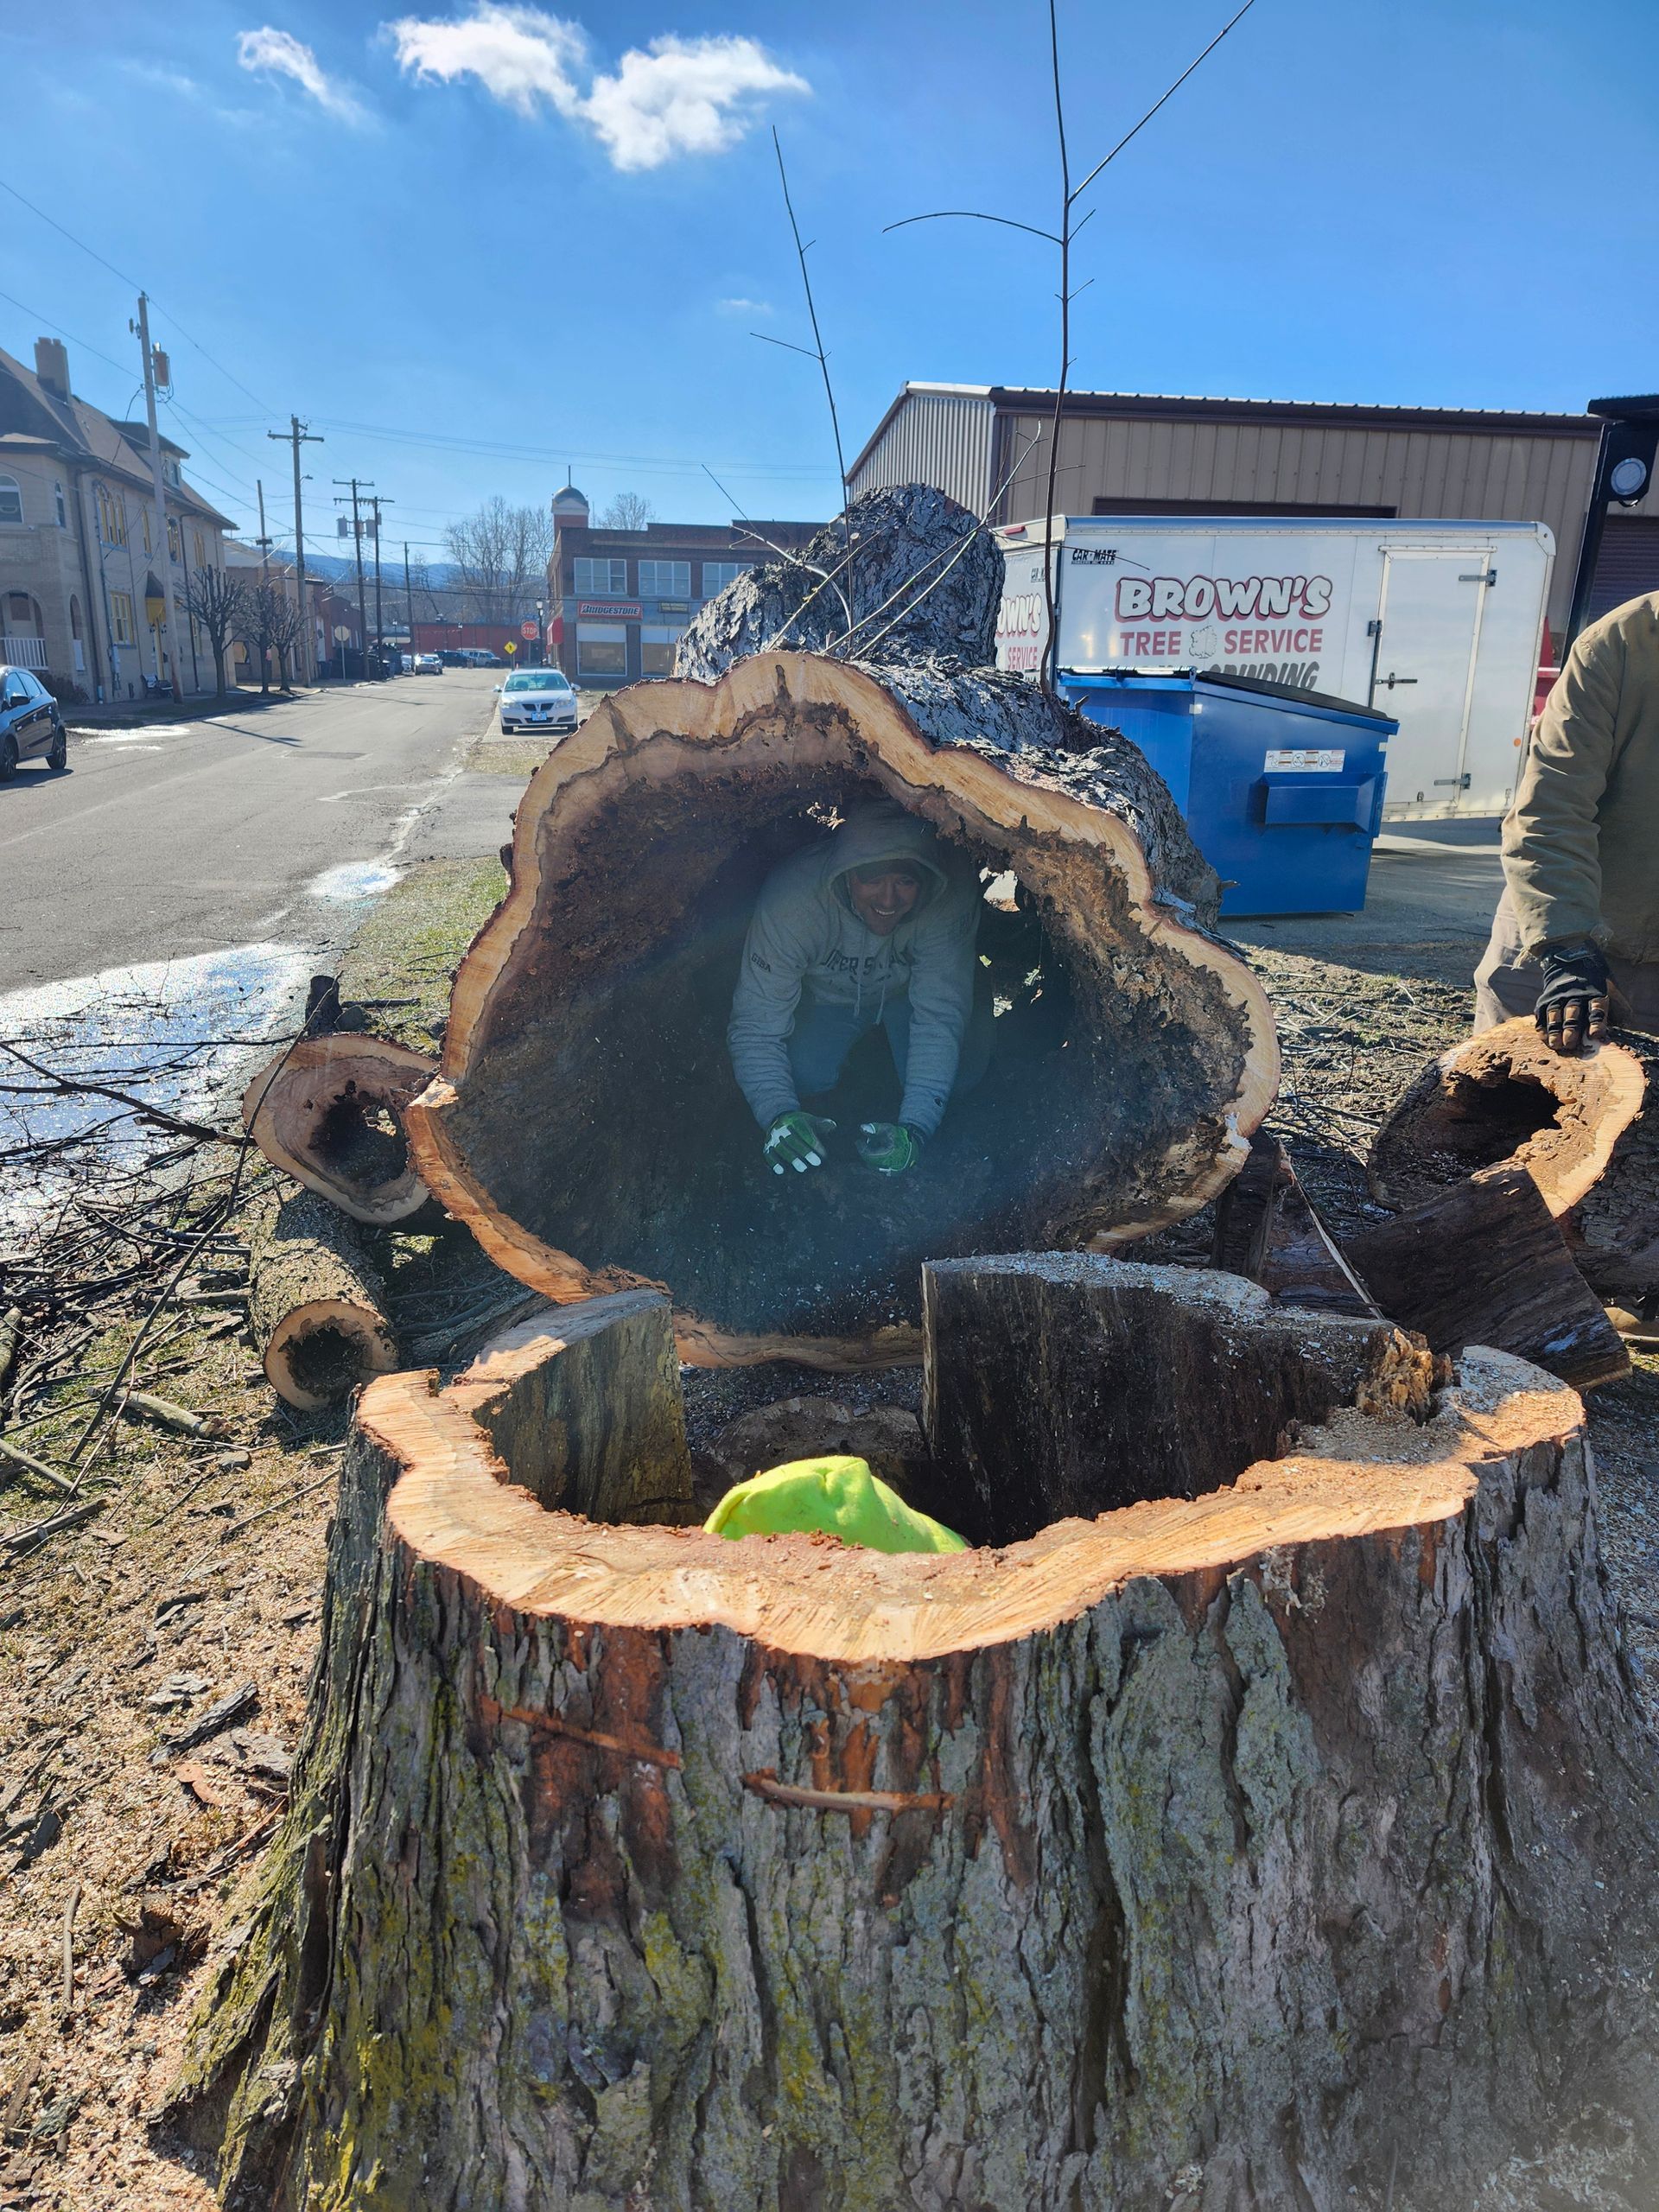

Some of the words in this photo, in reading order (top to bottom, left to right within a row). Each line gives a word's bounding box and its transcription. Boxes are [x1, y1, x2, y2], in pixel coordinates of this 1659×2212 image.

[581, 603, 640, 616] BRIDGESTONE
[1115, 575, 1333, 623] BROWN'S
[995, 593, 1042, 638] OWN'S
[522, 626, 537, 635] STOP
[1120, 631, 1182, 656] TREE
[1224, 628, 1323, 655] SERVICE
[1007, 646, 1038, 671] SERVICE
